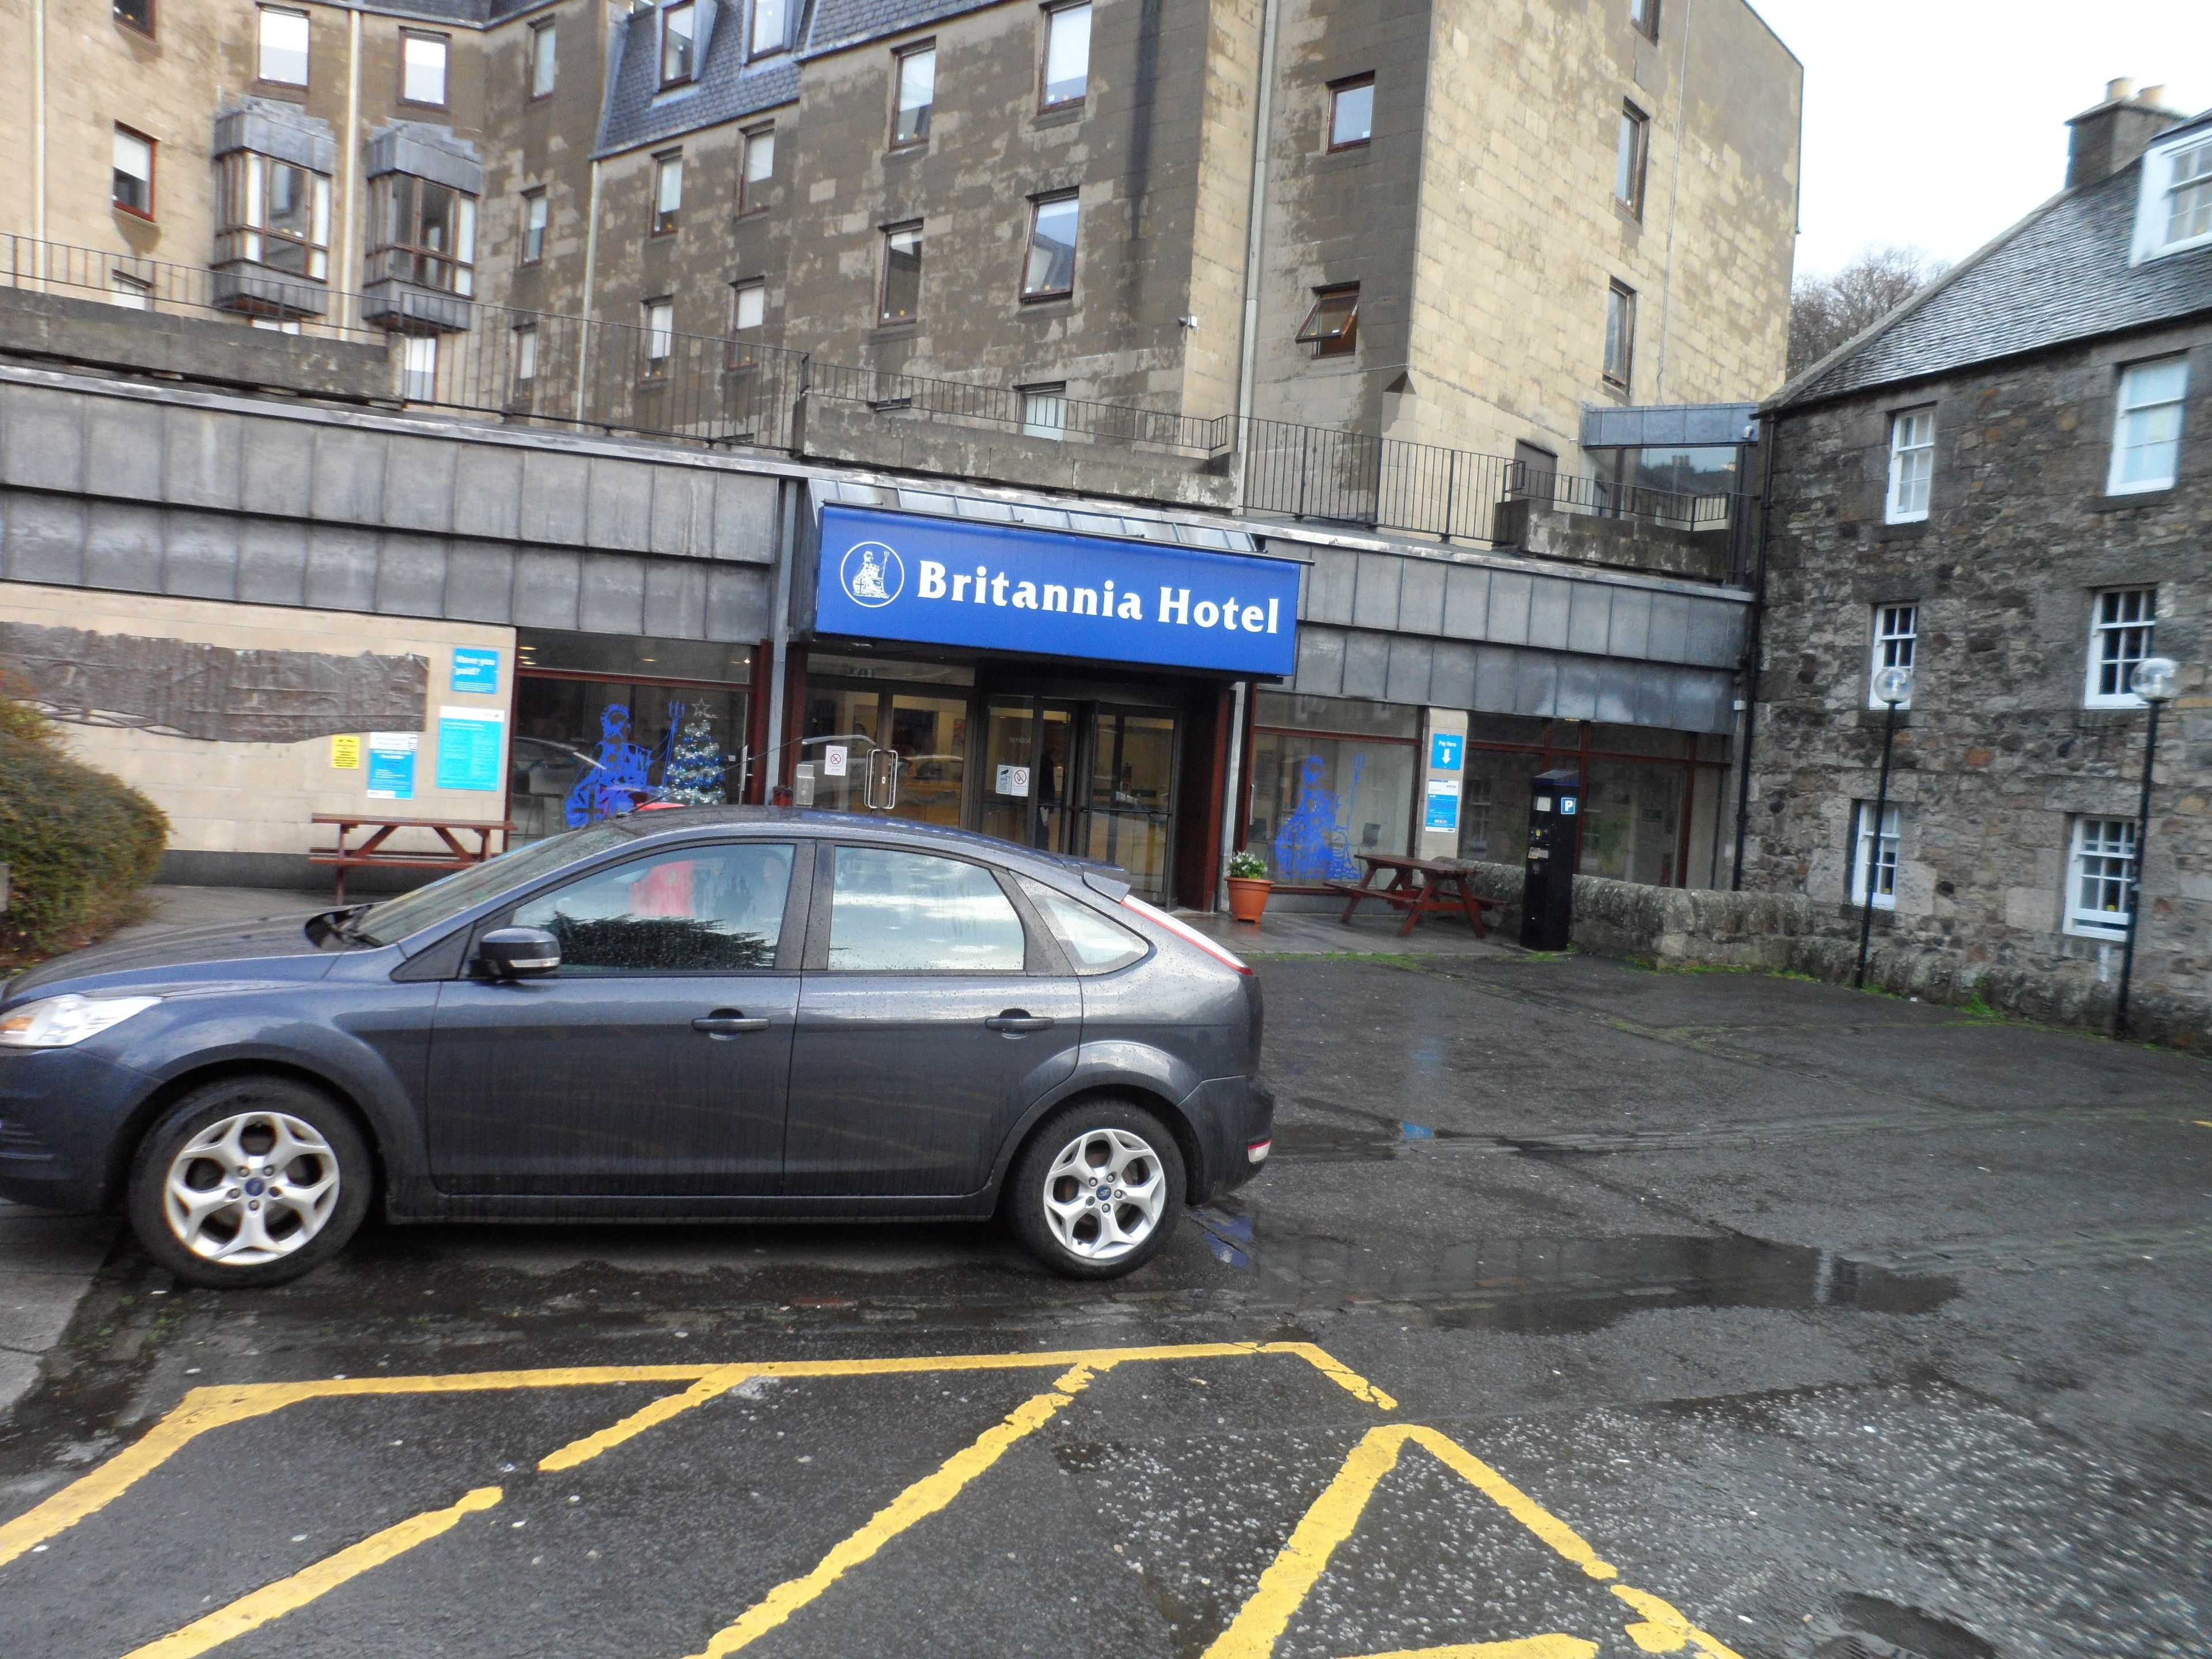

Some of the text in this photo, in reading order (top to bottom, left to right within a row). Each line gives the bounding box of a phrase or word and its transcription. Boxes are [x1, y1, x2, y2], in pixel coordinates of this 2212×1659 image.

[918, 560, 1279, 634] Britannia Hotel
[1565, 800, 1573, 812] P
